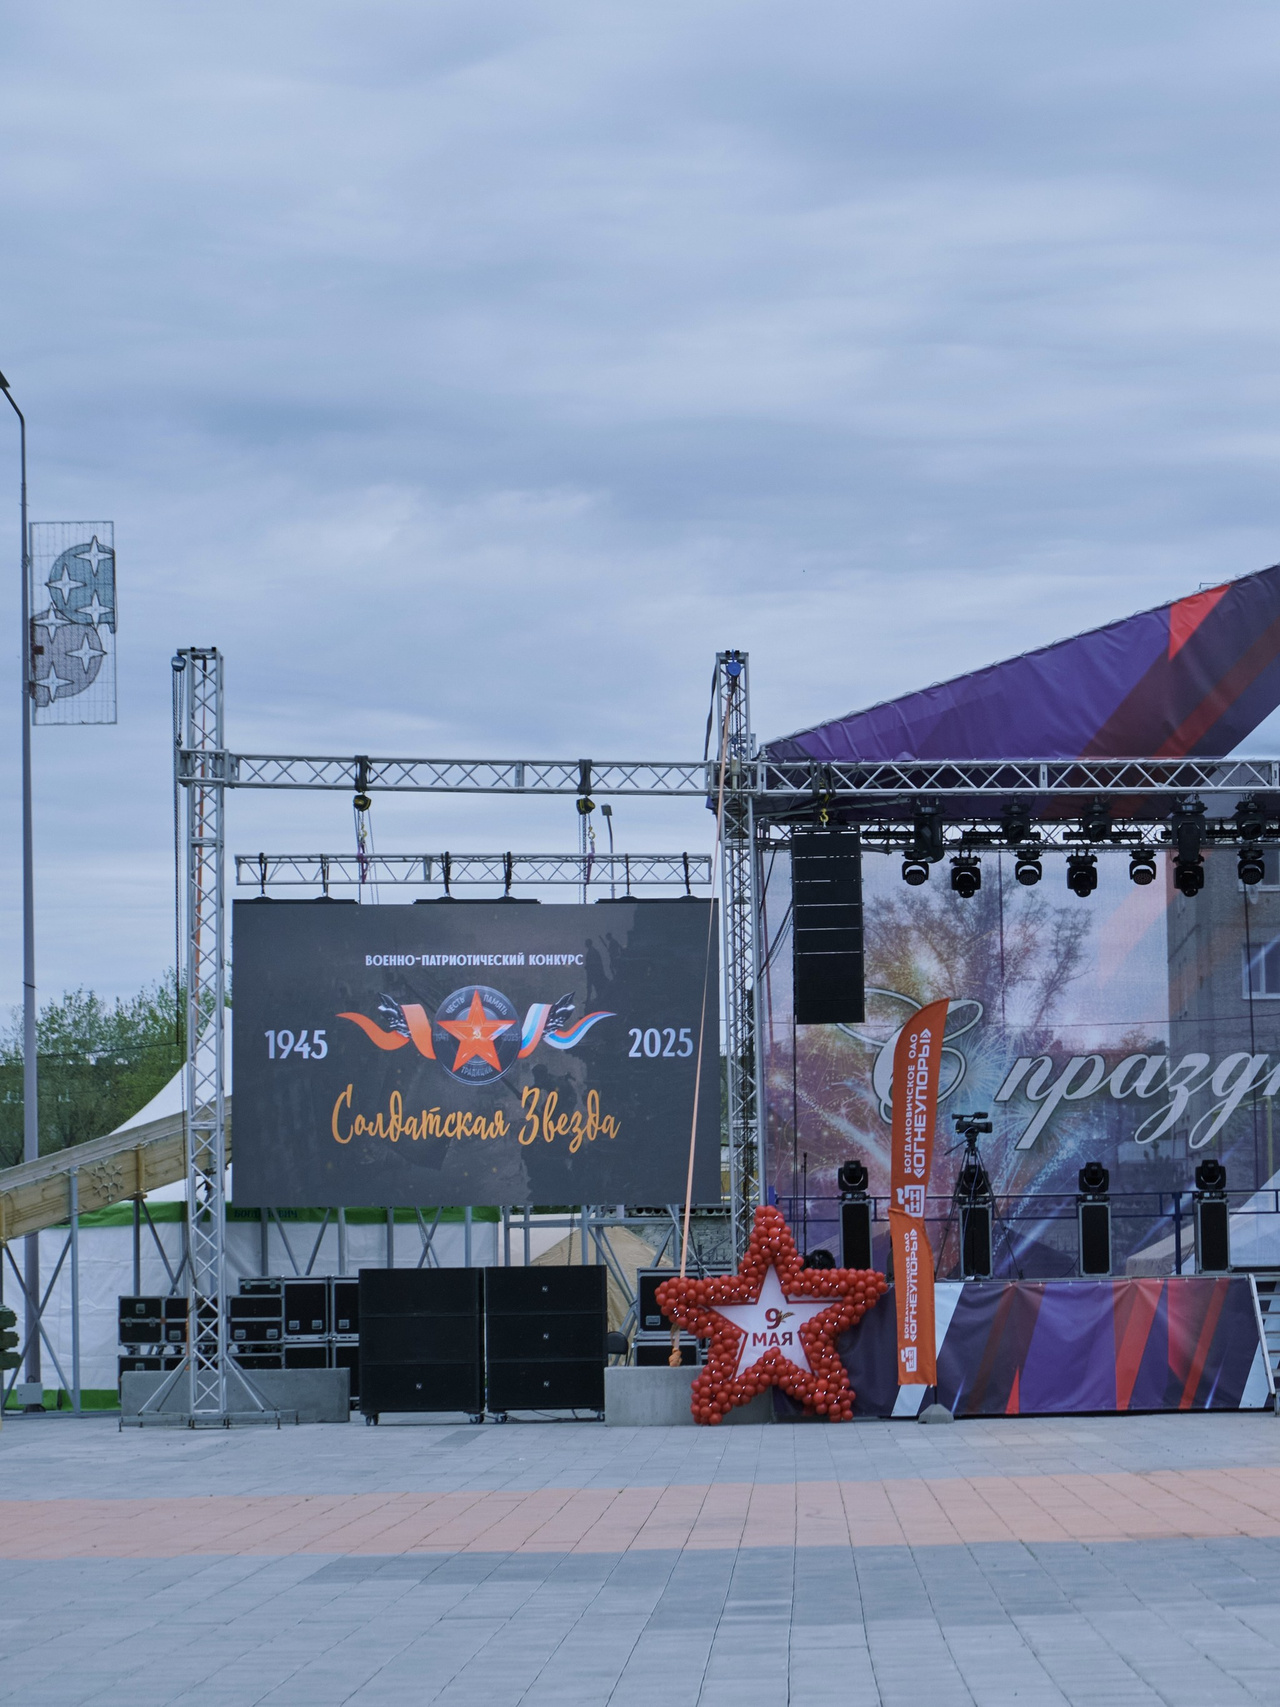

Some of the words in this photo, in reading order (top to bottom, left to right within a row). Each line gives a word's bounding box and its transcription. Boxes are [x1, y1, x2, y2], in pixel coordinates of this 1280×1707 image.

[365, 952, 525, 966] ВОЕННО-ПАТРИОТИЧЕСКИЙ
[529, 954, 584, 966] КОНКУРС
[445, 995, 466, 1015] ЧЕСТЬ
[483, 993, 508, 1016] ПАМЯТЬ
[264, 1028, 328, 1060] 1945
[627, 1027, 694, 1058] 2025
[908, 1033, 918, 1059] ОАО
[913, 1027, 932, 1178] «ОГНЕУПОРЫ»
[331, 1083, 510, 1144] Солдатская
[518, 1086, 622, 1154] Звезда
[904, 1064, 916, 1174] БОГДАНОВИЧСКОЕ
[910, 1228, 918, 1342] «ОГНЕУПОРЫ»
[765, 1308, 782, 1330] 9
[752, 1332, 793, 1347] МАЯ
